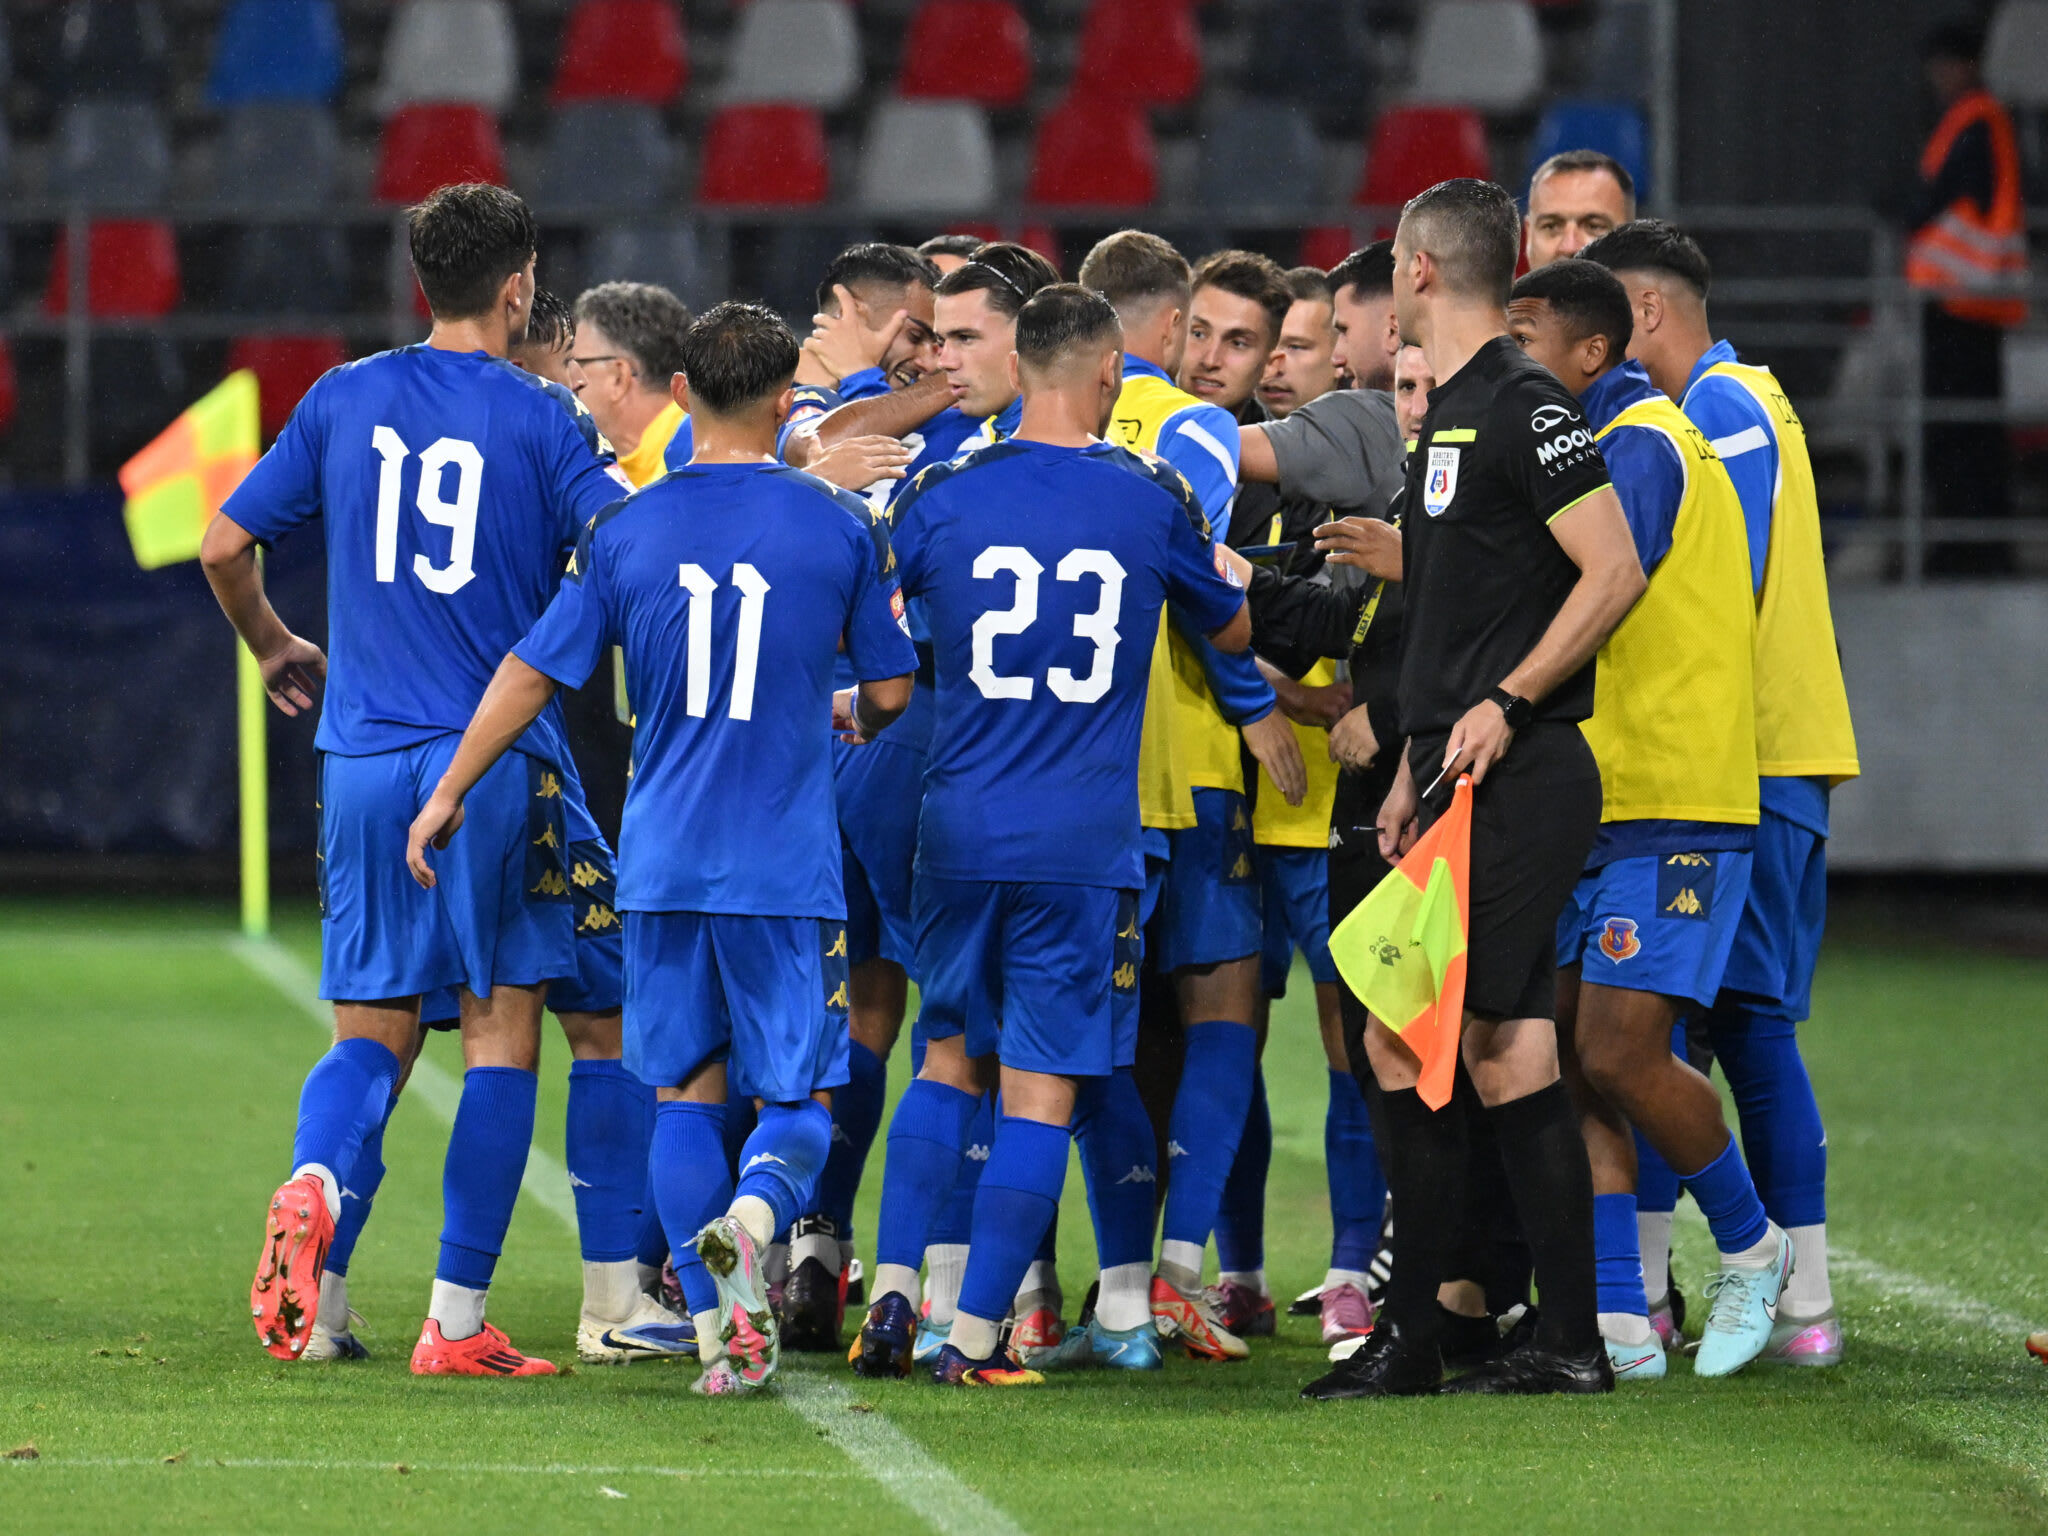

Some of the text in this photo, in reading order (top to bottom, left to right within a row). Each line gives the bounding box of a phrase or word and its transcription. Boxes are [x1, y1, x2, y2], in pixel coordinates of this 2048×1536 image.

[372, 426, 485, 594] 19
[1536, 428, 1594, 465] MOOV
[679, 563, 770, 721] 11
[969, 546, 1127, 704] 23
